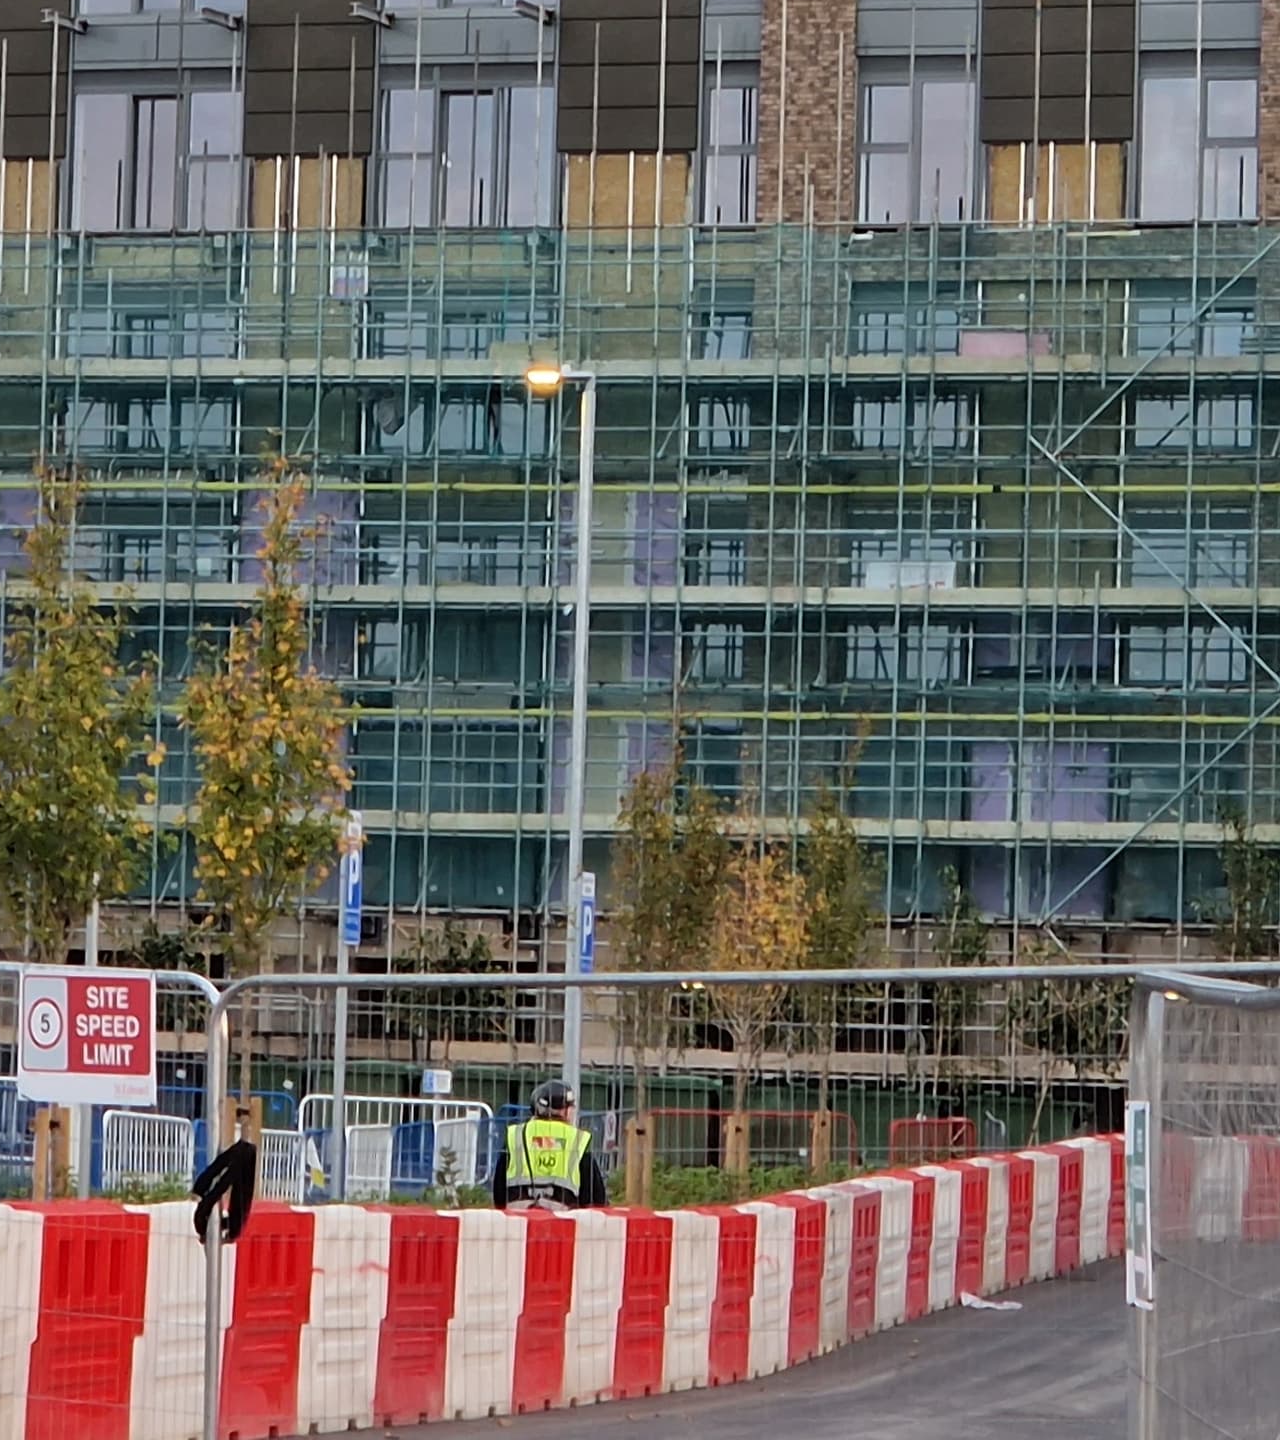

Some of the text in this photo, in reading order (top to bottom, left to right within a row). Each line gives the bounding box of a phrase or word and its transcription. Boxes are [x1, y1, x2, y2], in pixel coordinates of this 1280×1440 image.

[348, 850, 359, 905] P
[582, 905, 592, 953] P
[86, 986, 129, 1009] SITE
[40, 1013, 50, 1033] 5
[76, 1014, 140, 1037] SPEED
[83, 1043, 134, 1066] LIMIT
